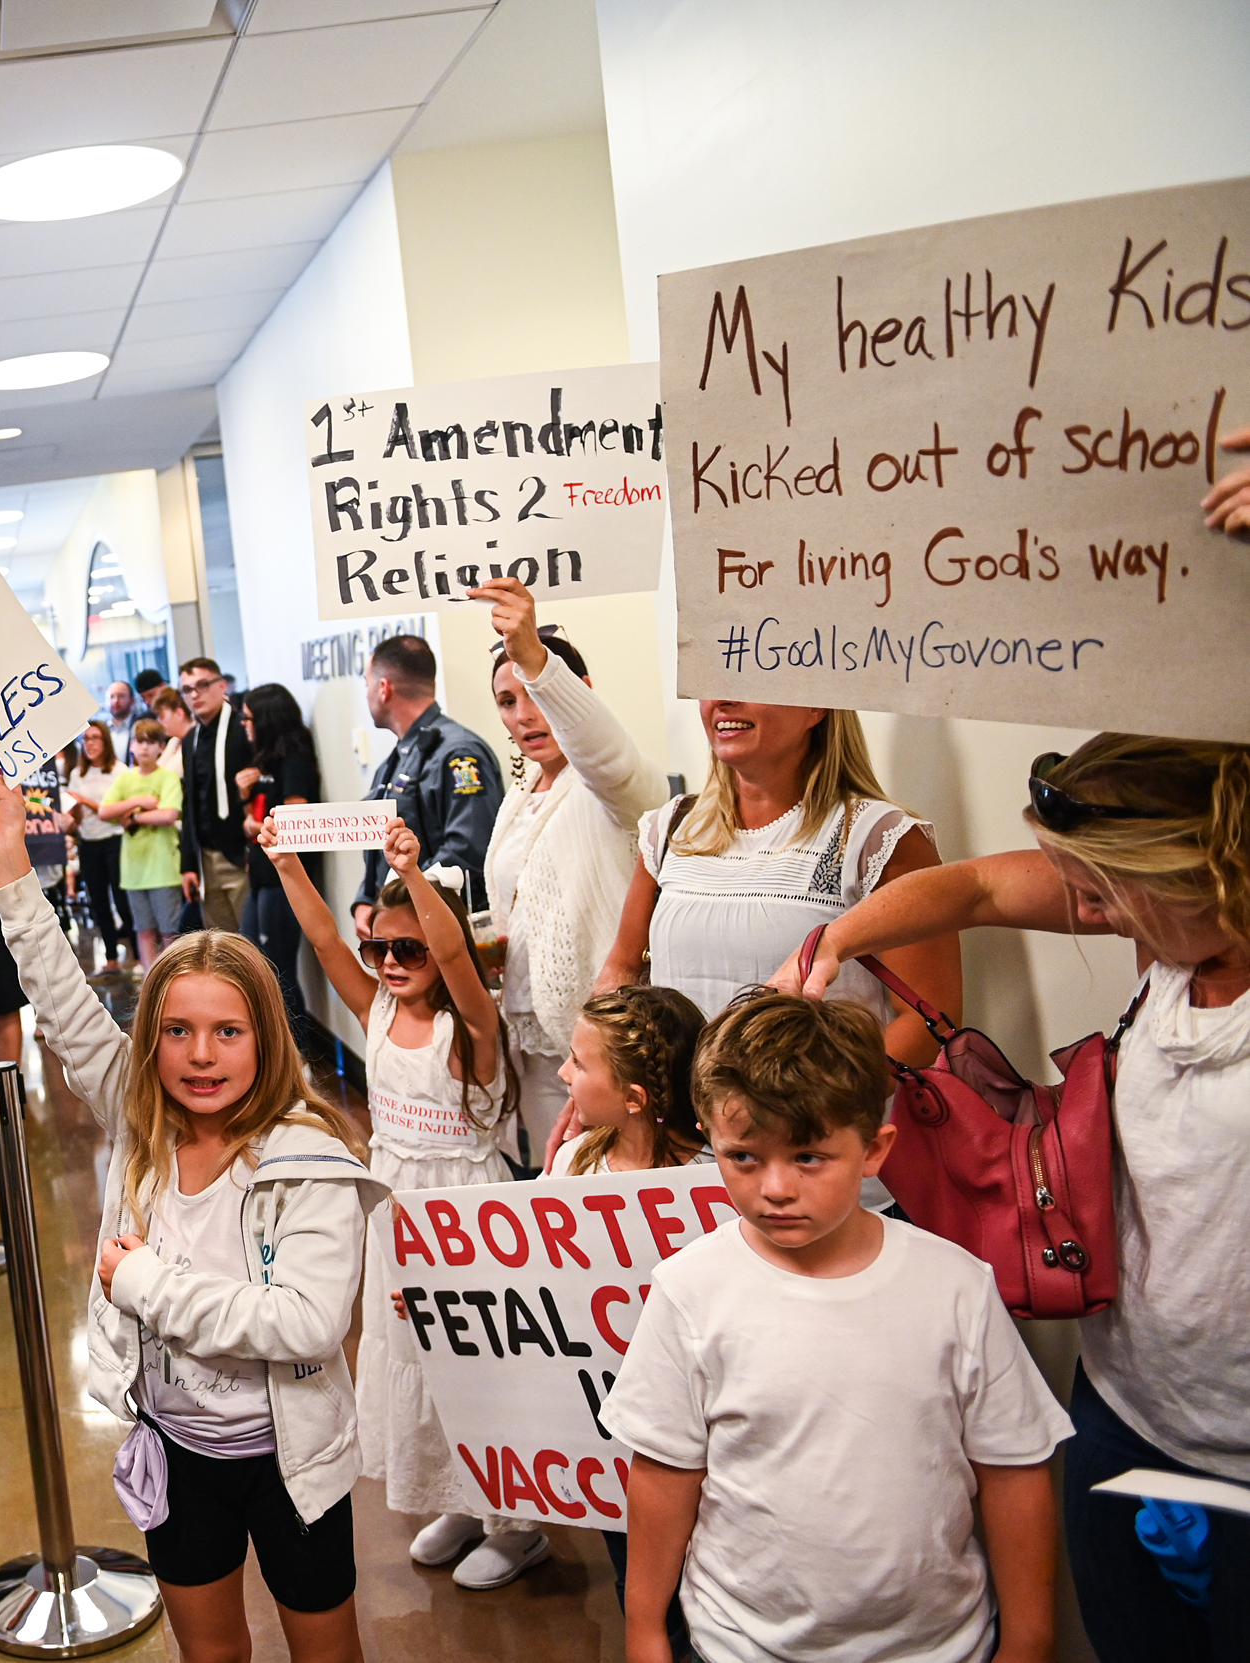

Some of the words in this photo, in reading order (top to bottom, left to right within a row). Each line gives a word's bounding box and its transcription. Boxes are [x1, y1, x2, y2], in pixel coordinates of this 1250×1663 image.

[698, 285, 792, 427] My
[836, 267, 1056, 388] healthy
[1107, 235, 1250, 334] Kids
[310, 397, 375, 468] 1st
[382, 387, 663, 463] Amendment
[692, 436, 844, 514] Kicked
[866, 421, 959, 493] out
[985, 405, 1043, 480] of
[1061, 386, 1227, 485] school
[324, 475, 502, 543] Rights
[517, 475, 564, 523] 2
[562, 475, 662, 508] Freedom
[336, 540, 583, 606] Religion
[715, 546, 775, 594] For
[797, 538, 893, 608] living
[923, 525, 1061, 587] God's
[1087, 538, 1190, 604] way.
[300, 628, 366, 682] MEETING
[278, 832, 335, 846] ADDITIVE
[318, 816, 359, 829] CAUSE
[338, 830, 388, 843] ACCINE
[362, 814, 389, 827] CAN
[378, 1109, 415, 1130] CAUSE
[418, 1120, 470, 1137] INJURY
[399, 1102, 469, 1123] ADDITIVE
[401, 1286, 594, 1359] FETAL
